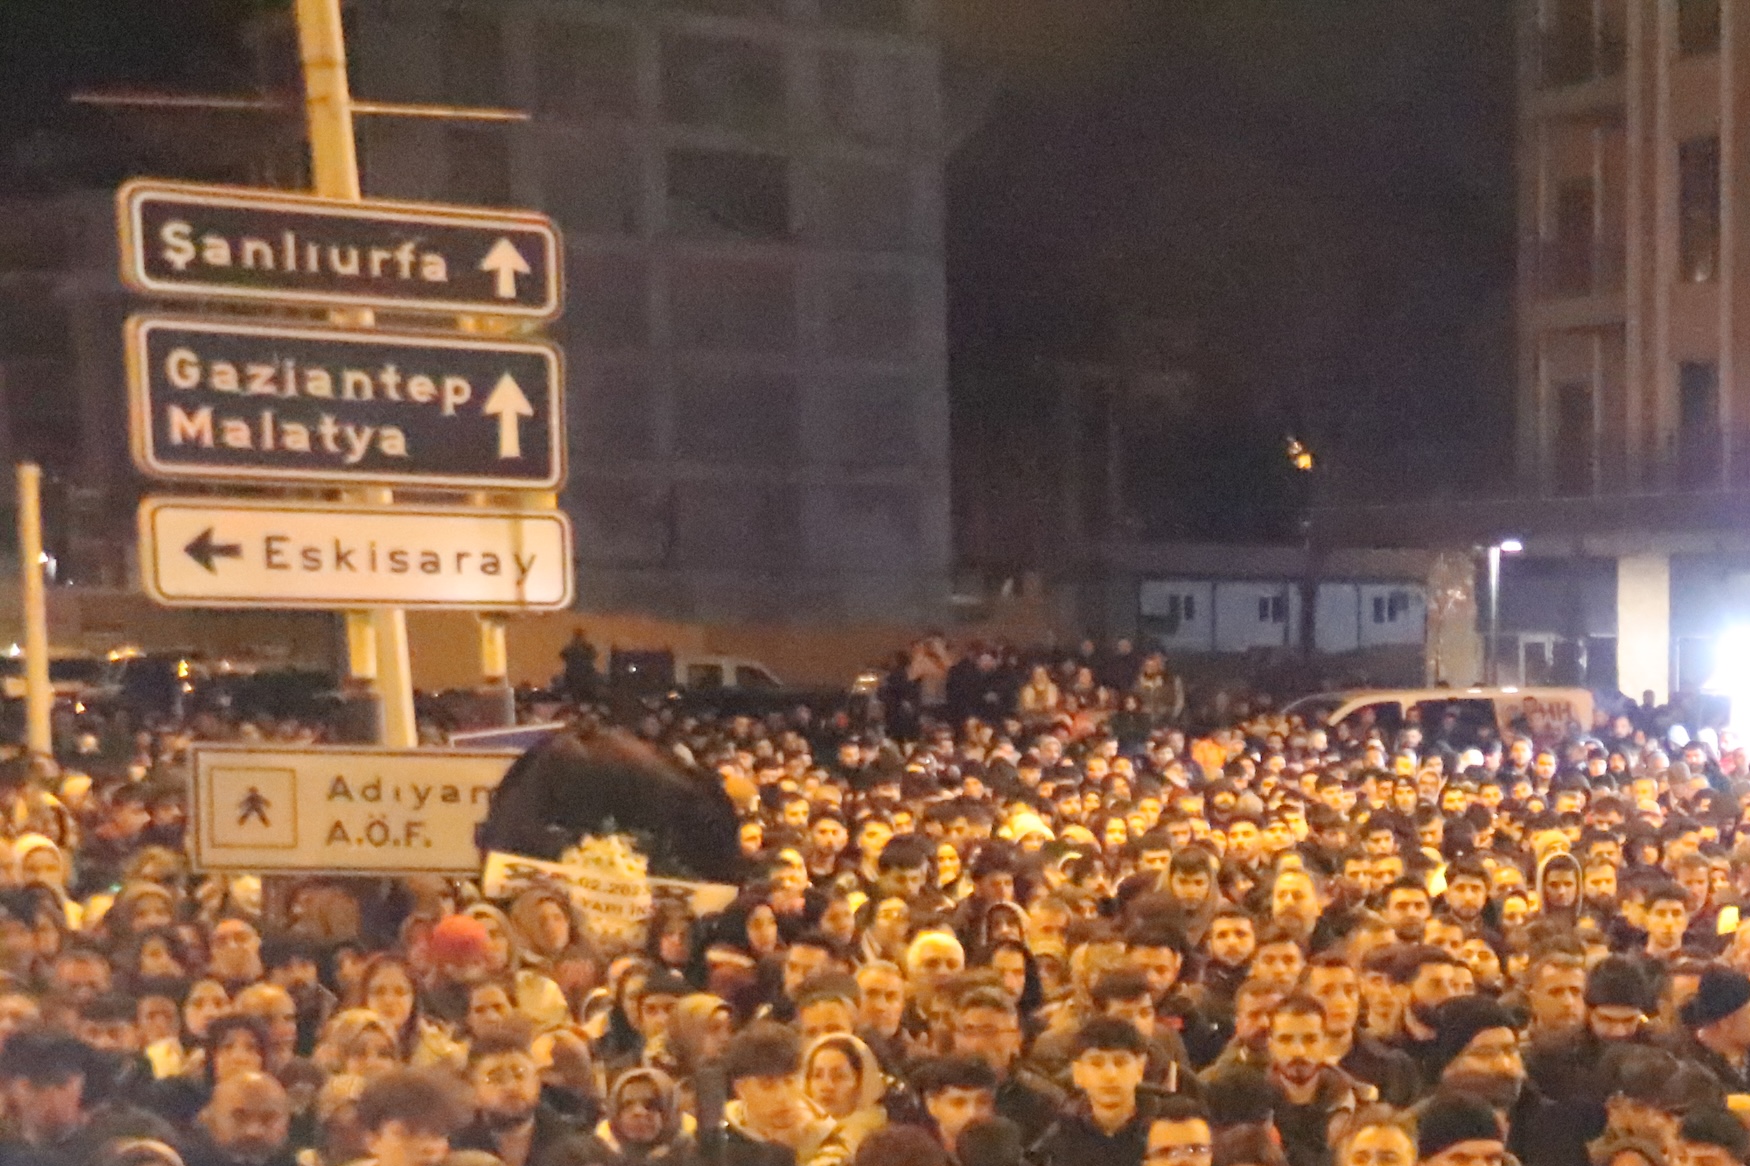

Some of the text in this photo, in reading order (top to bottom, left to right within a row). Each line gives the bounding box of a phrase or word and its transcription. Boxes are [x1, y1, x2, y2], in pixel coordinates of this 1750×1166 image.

[160, 220, 448, 282] Şanlıurfa
[166, 349, 472, 415] Gaziantep
[168, 404, 408, 463] Malatya
[264, 534, 536, 587] Eskisaray
[326, 813, 432, 848] A.Ö.F.
